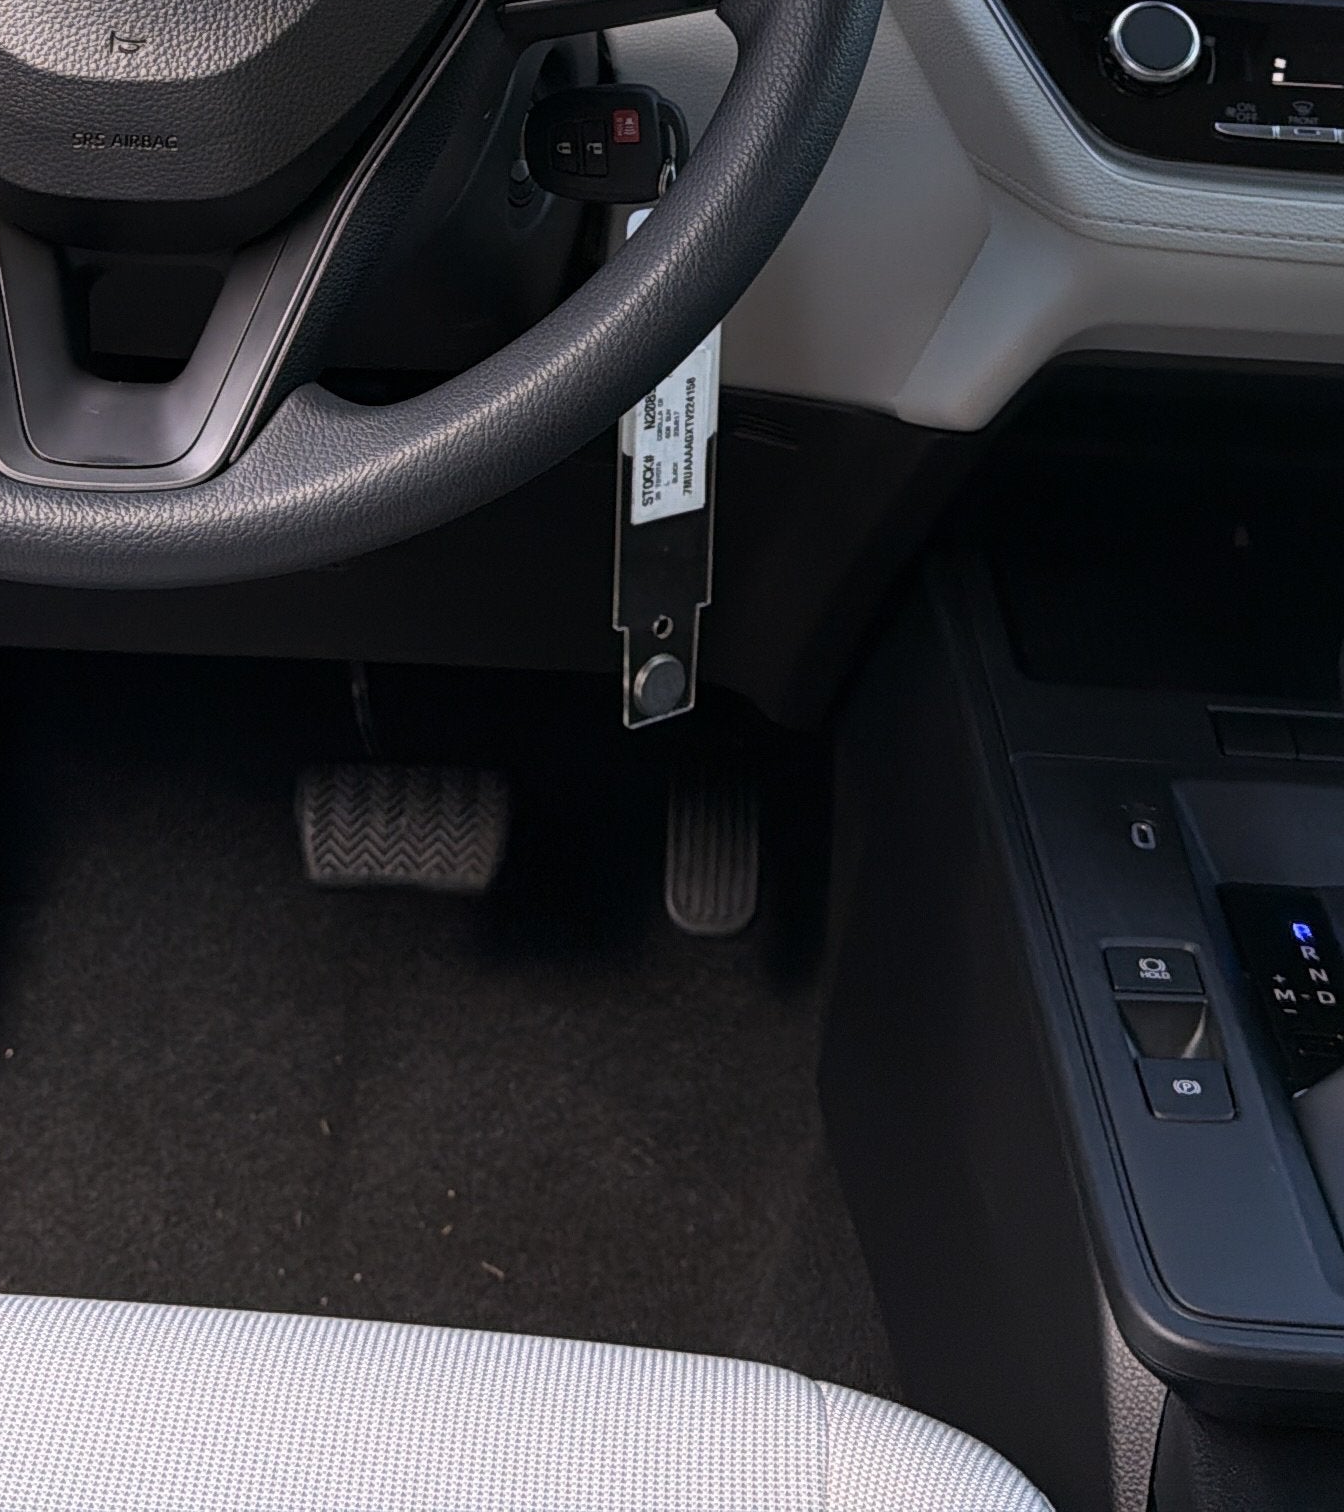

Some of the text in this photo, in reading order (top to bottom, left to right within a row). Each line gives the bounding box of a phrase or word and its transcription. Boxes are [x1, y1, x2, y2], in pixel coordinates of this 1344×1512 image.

[1236, 102, 1256, 113] ON
[1236, 112, 1258, 122] OFF
[71, 132, 179, 151] SRS AIRBAG
[642, 454, 655, 508] STOCK#
[1300, 945, 1320, 961] R
[1139, 970, 1171, 981] HOLD
[1308, 967, 1330, 983] N
[1273, 988, 1297, 1002] M
[1316, 990, 1336, 1004] D
